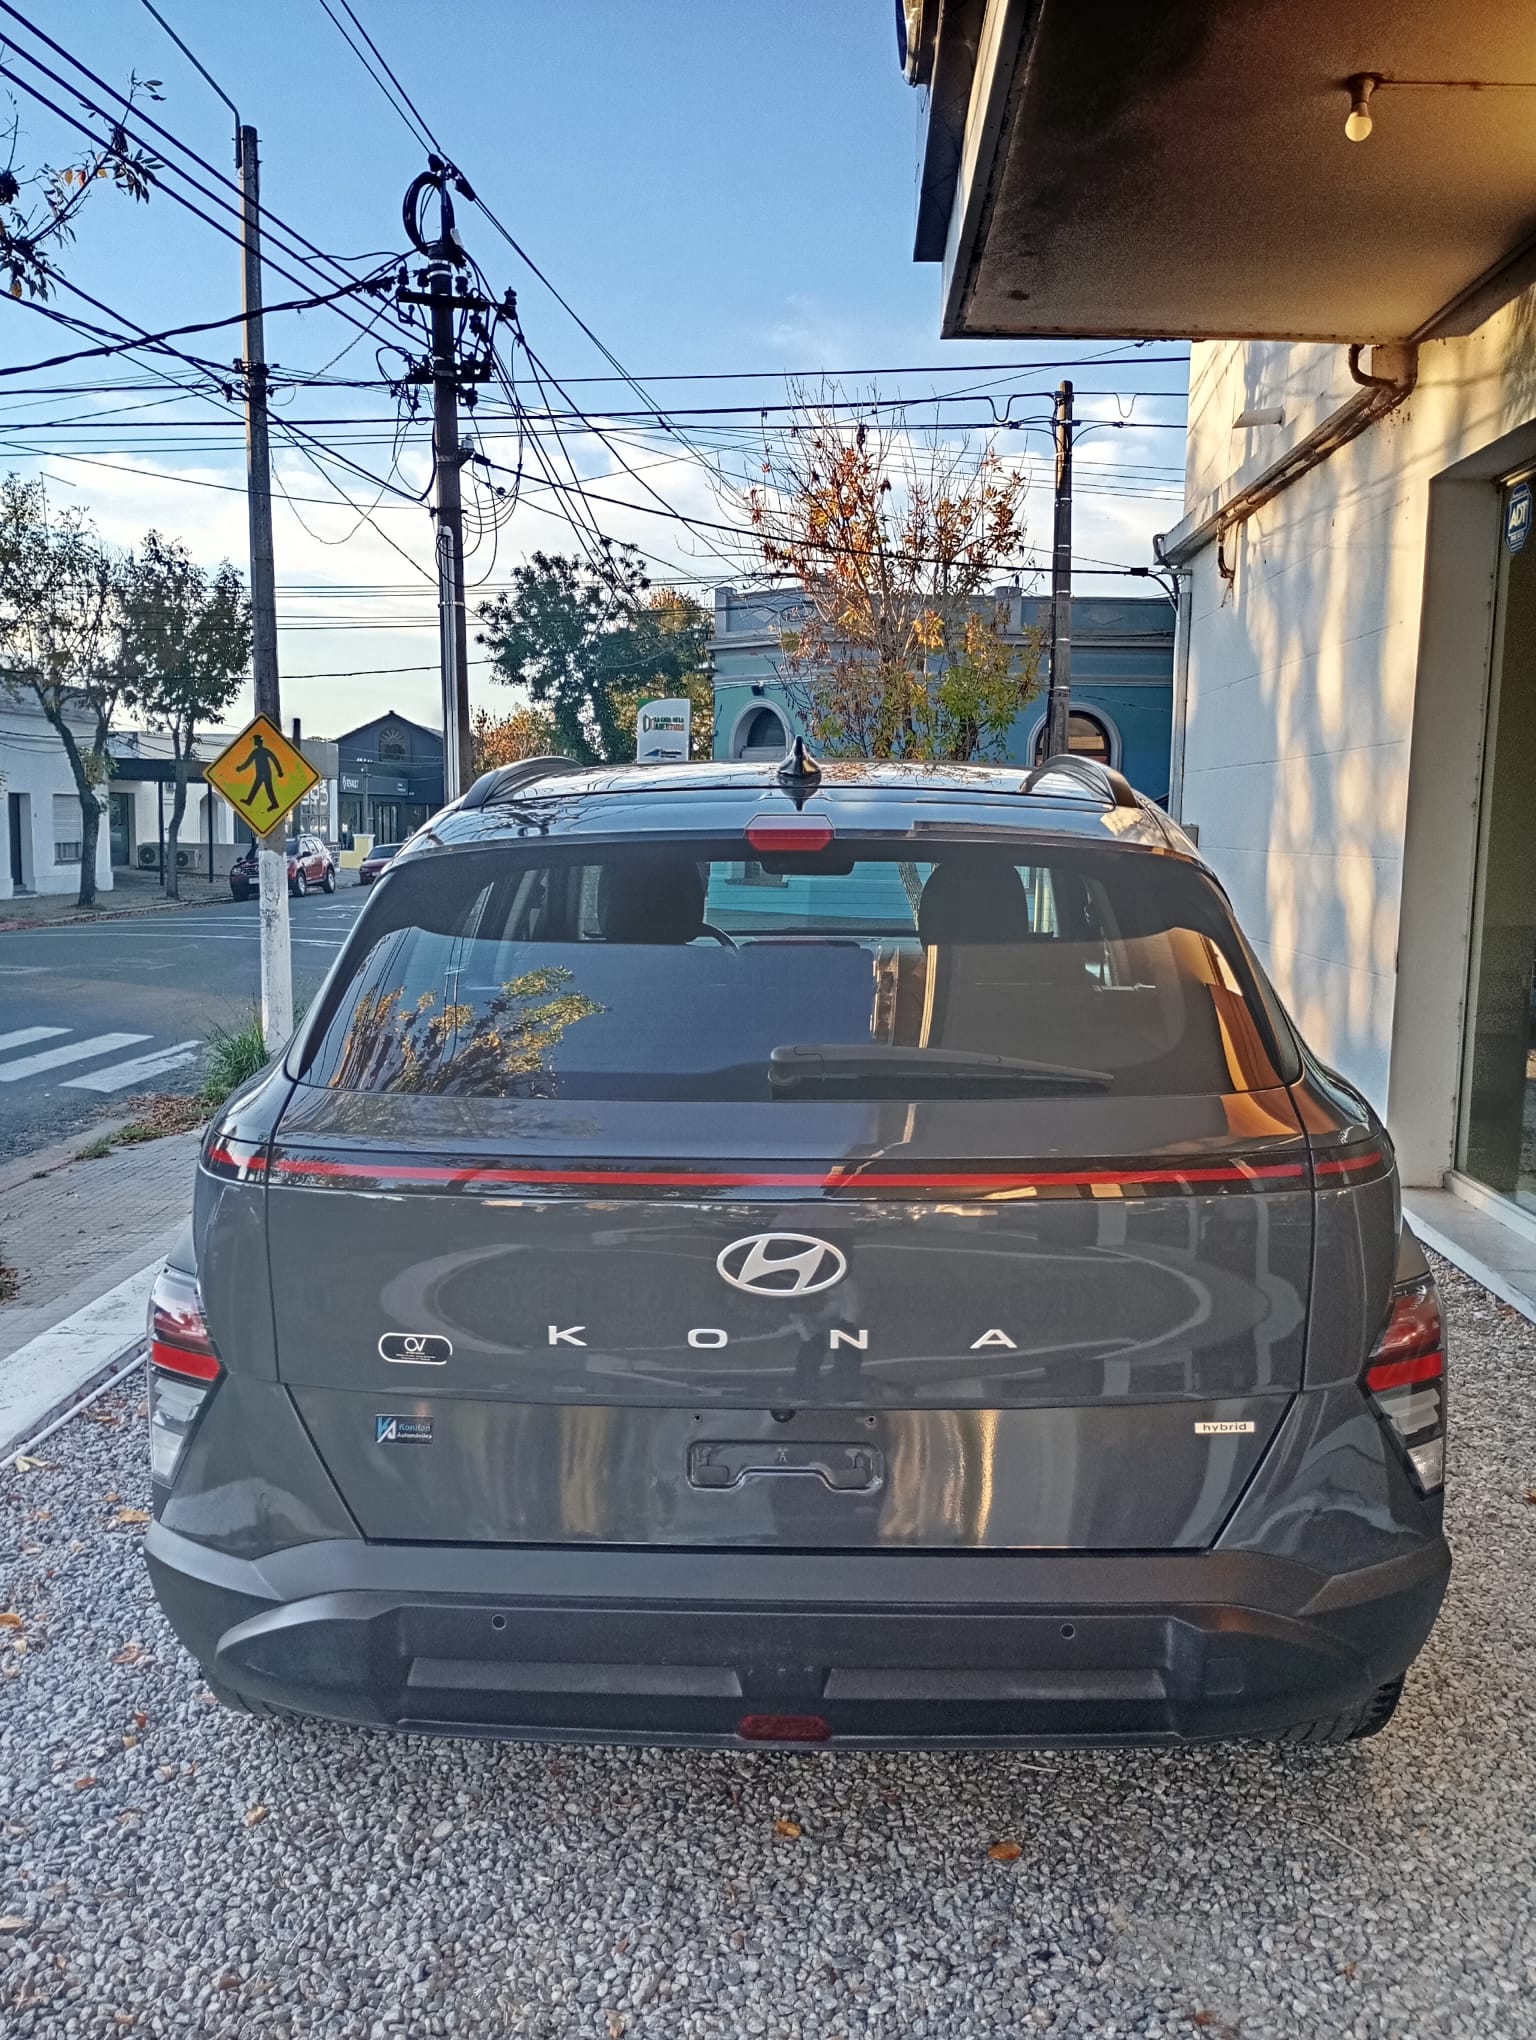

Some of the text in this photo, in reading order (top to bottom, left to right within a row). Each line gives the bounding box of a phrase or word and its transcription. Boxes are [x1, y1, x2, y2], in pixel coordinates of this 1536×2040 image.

[1509, 500, 1528, 529] ADT
[547, 1325, 1018, 1350] KONA
[1202, 1423, 1247, 1432] hybrid
